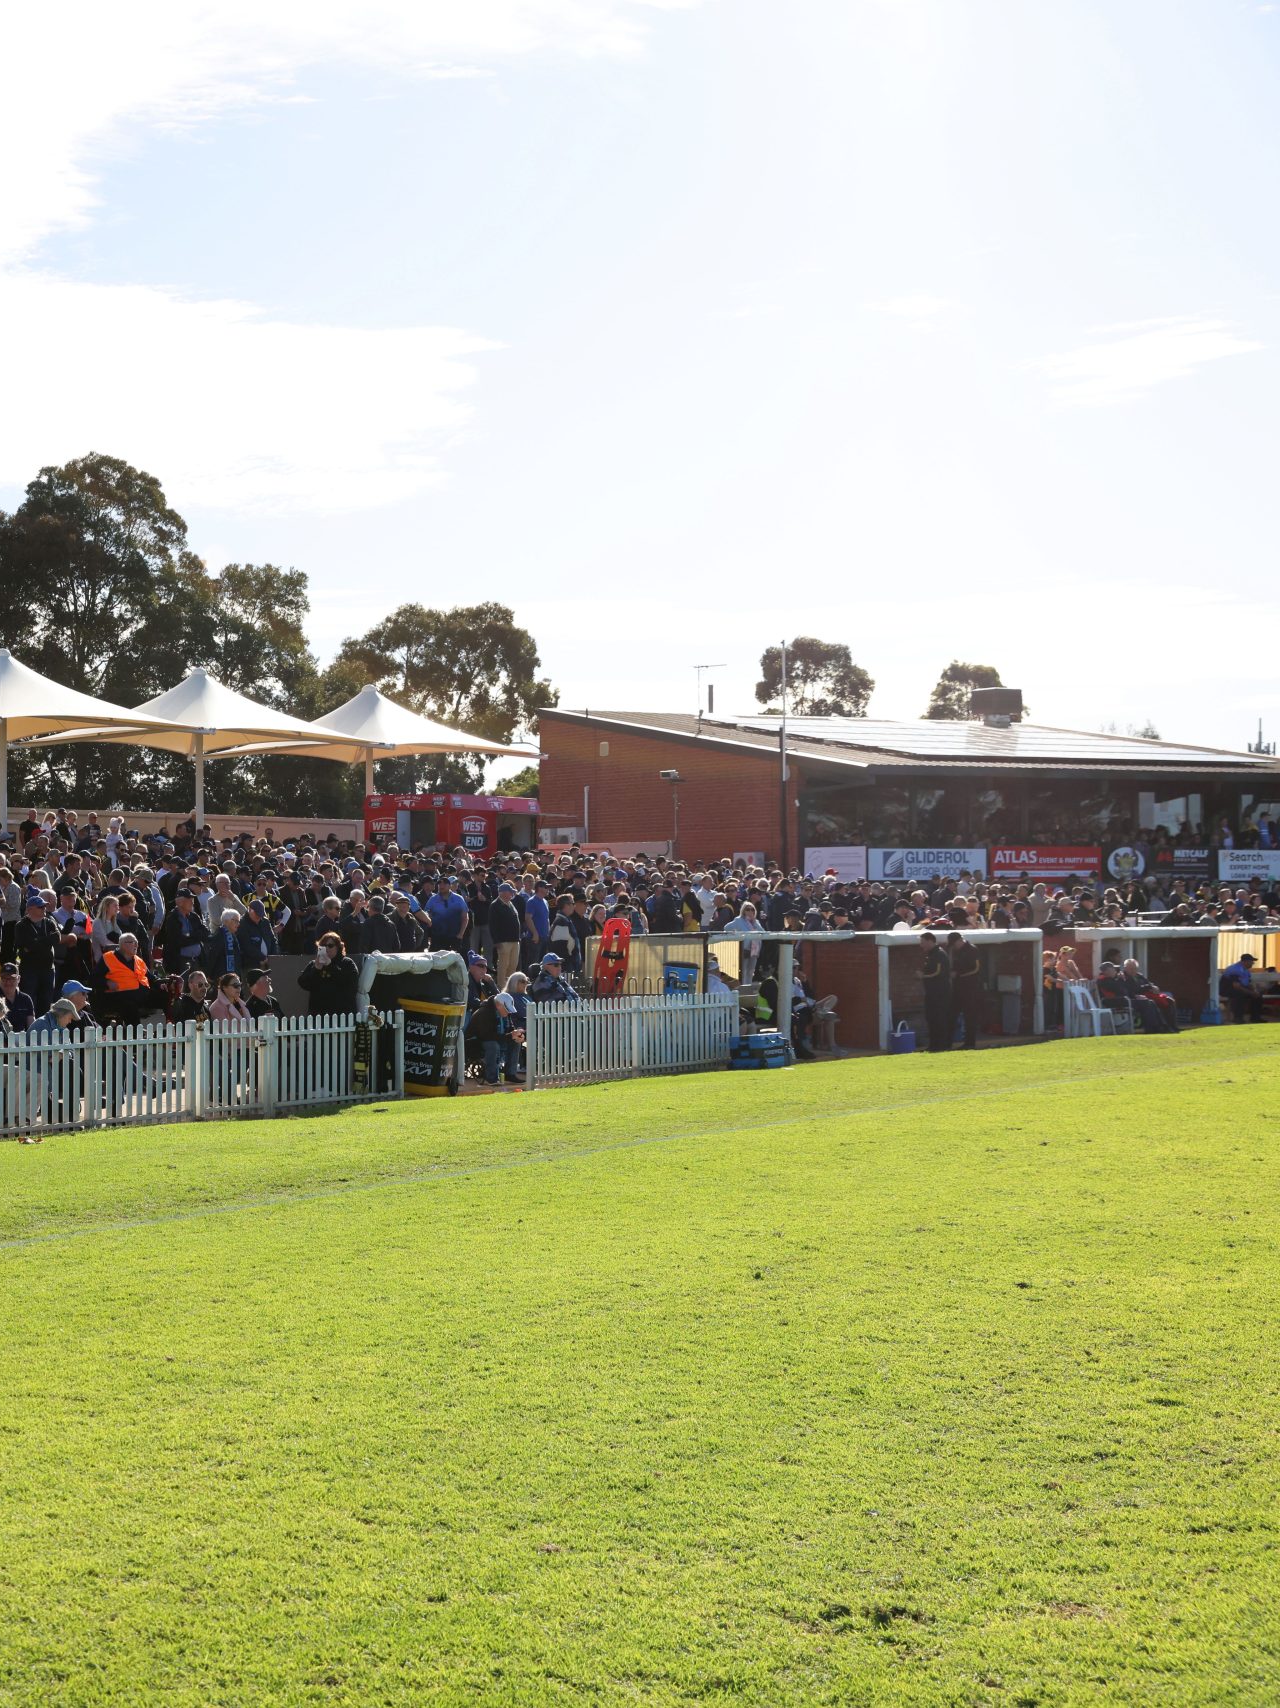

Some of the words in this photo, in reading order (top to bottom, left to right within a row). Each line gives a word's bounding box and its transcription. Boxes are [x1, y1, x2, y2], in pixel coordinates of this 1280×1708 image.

[372, 822, 396, 831] WES
[462, 821, 487, 832] WEST
[465, 837, 484, 847] END
[905, 851, 969, 864] GLIDEROL
[994, 850, 1037, 864] ATLAS
[1174, 849, 1209, 858] METCALF
[1229, 852, 1264, 862] Search
[906, 866, 940, 878] garage
